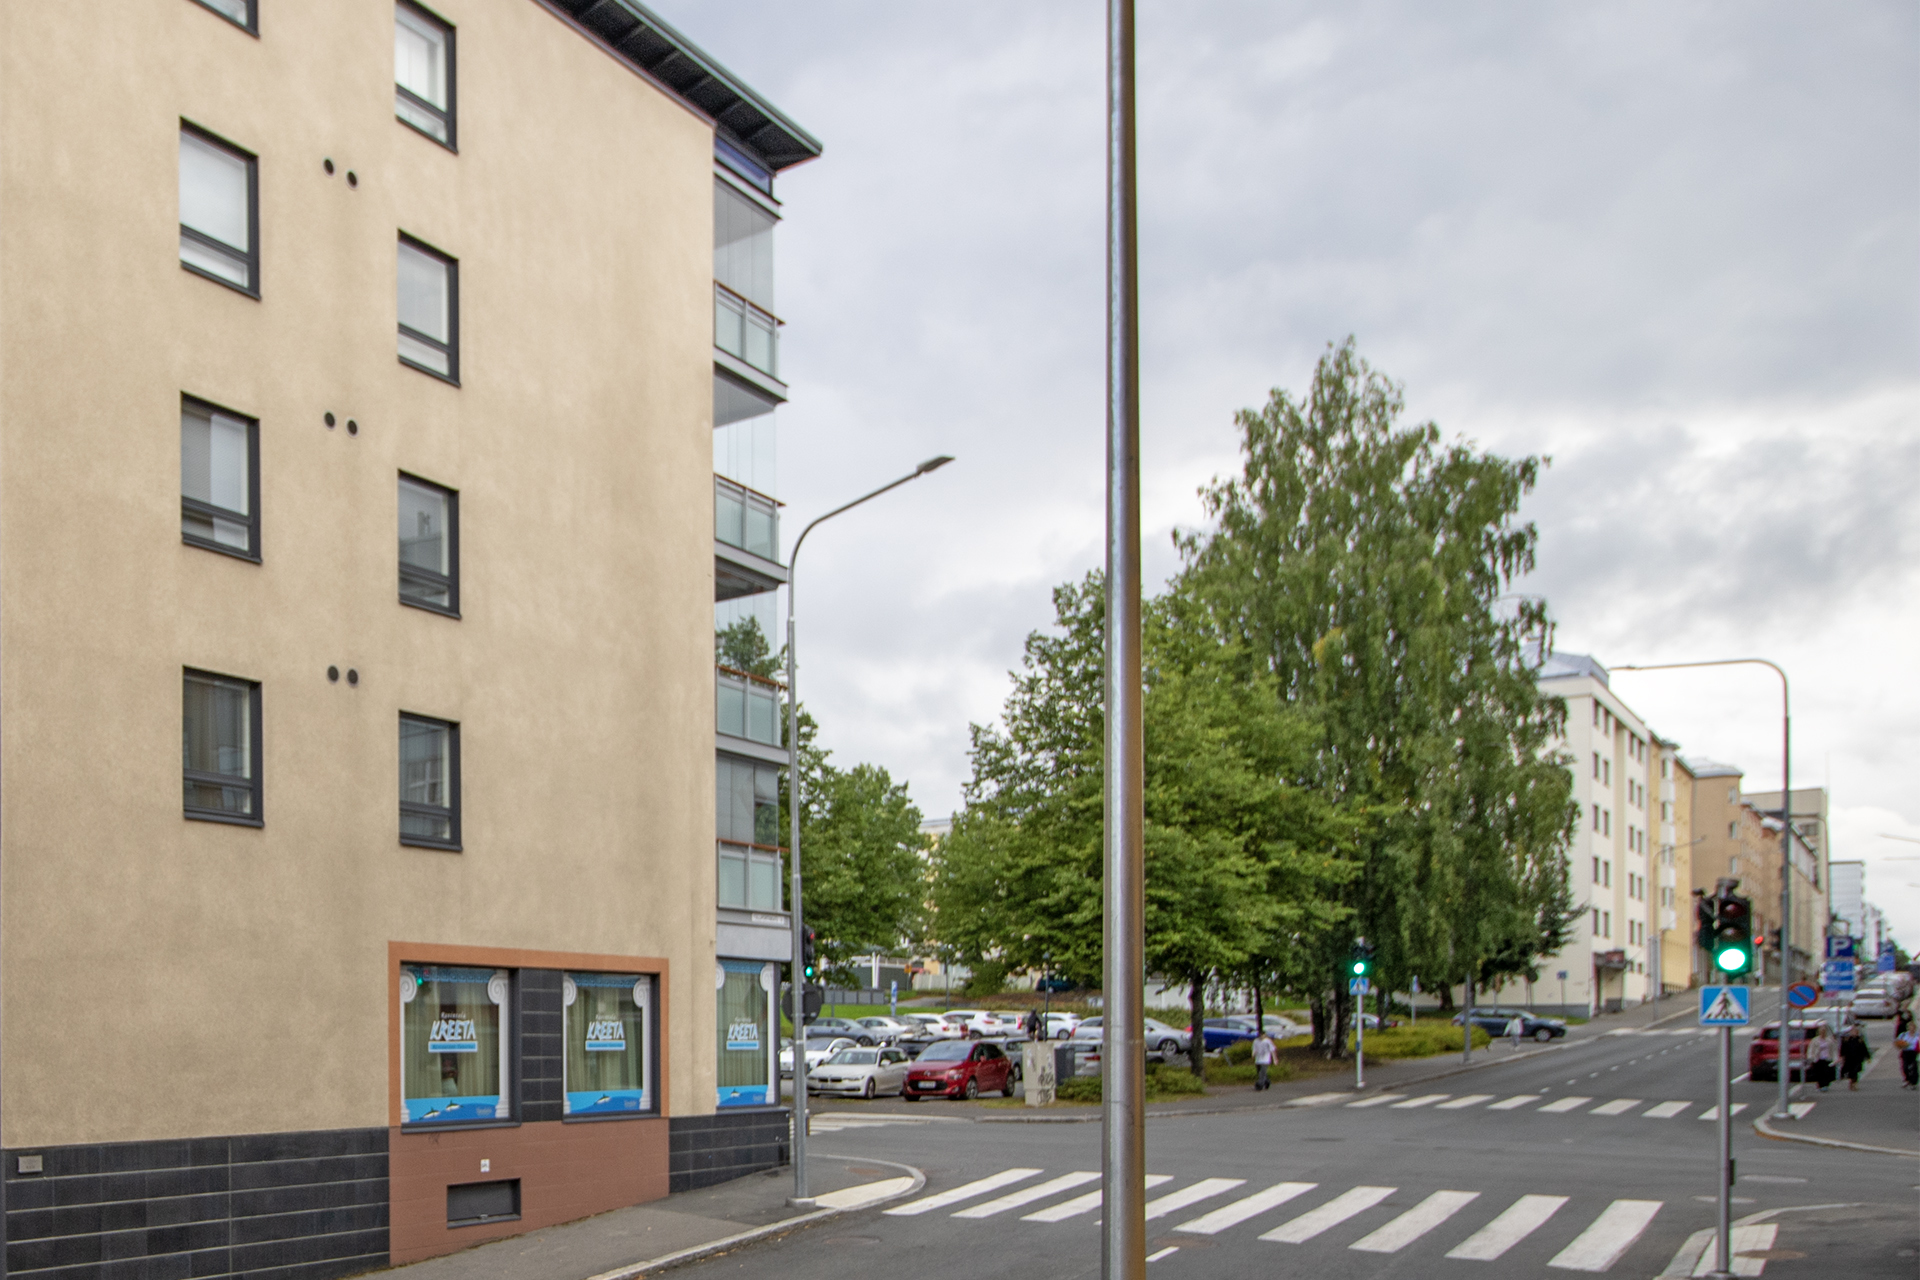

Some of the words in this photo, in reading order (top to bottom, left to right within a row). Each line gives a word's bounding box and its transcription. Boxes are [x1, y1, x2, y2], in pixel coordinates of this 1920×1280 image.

[1830, 937, 1851, 956] P
[430, 1019, 476, 1041] KREETA
[586, 1020, 625, 1041] KREETA
[727, 1023, 758, 1041] KREETA
